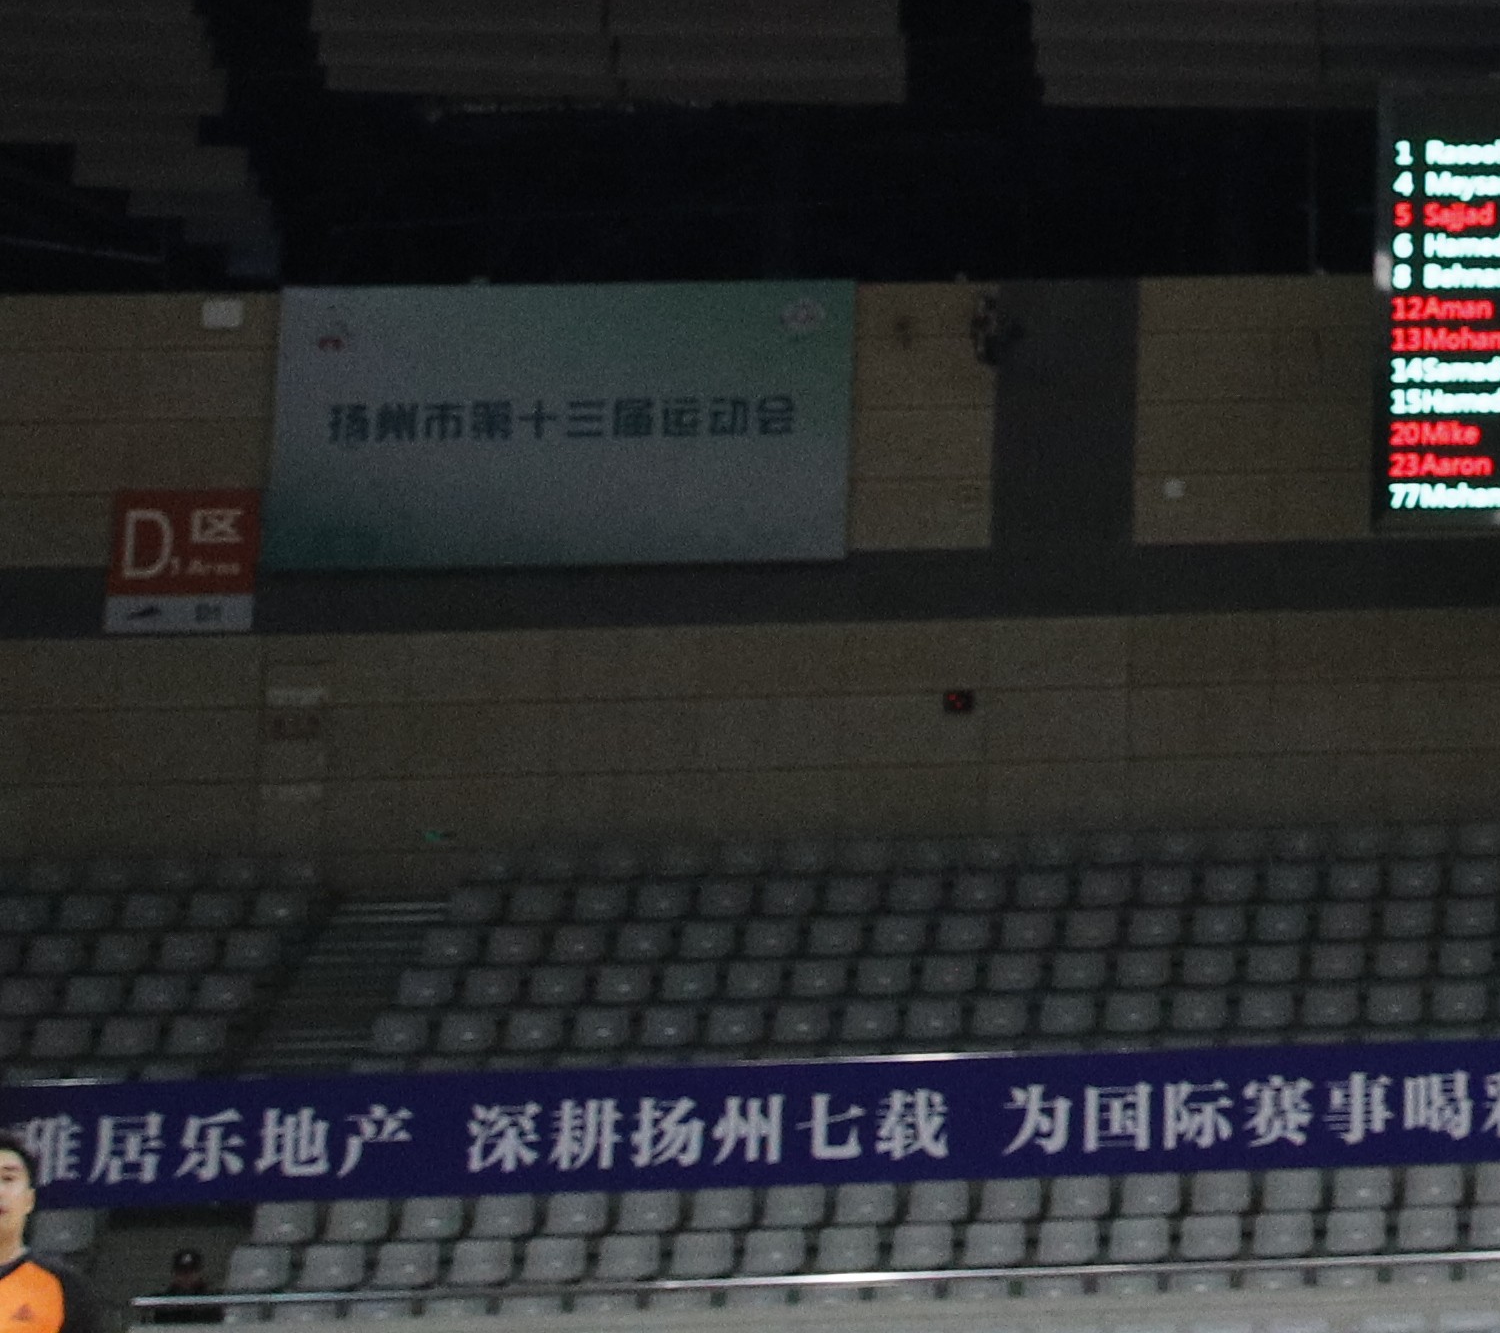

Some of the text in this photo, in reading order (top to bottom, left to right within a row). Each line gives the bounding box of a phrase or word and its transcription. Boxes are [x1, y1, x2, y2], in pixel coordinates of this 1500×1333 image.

[1395, 140, 1413, 165] 1
[1392, 171, 1414, 197] 4
[1393, 202, 1413, 227] 5
[1423, 201, 1496, 232] Sajjad
[1392, 233, 1414, 258] 6
[1392, 263, 1412, 289] 8
[328, 393, 796, 445] 扬州市第十三届运动会
[191, 508, 242, 543] 区
[467, 1087, 950, 1174] 深耕扬州七载
